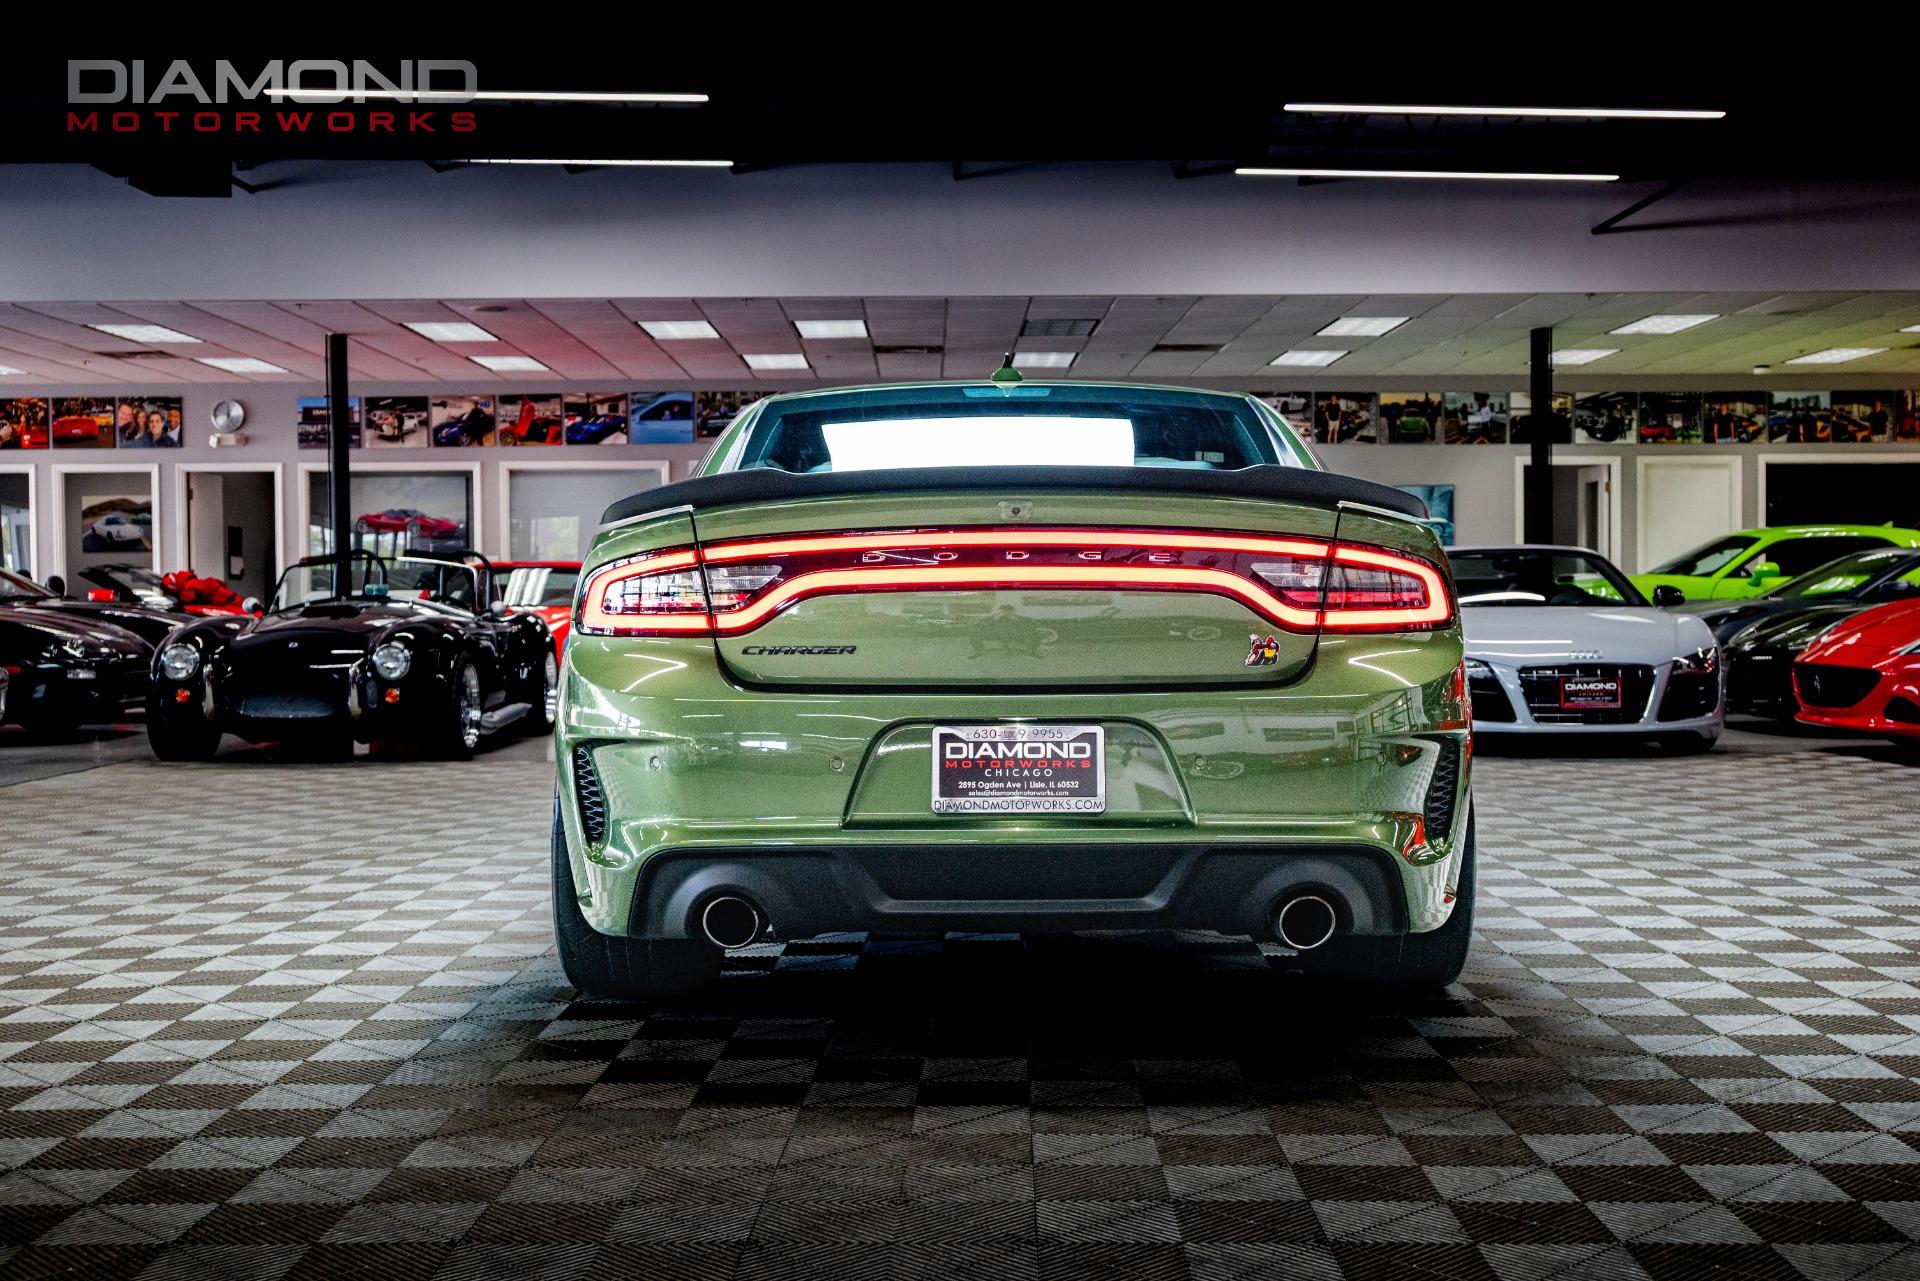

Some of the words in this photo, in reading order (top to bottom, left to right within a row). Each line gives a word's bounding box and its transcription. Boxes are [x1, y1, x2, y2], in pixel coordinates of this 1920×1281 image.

[862, 550, 1171, 563] DODGE
[741, 645, 857, 655] CHARGER
[1565, 682, 1617, 690] DIAMOND
[973, 729, 1063, 739] 630-59-9955
[945, 742, 1091, 759] DIAMOND
[945, 760, 1091, 768] MOTORWORKS
[984, 769, 1053, 777] CHICAGO
[958, 781, 976, 789] 2895
[978, 781, 1004, 790] Ogden
[1006, 781, 1021, 789] Ave
[934, 799, 1104, 811] DIAMONDMOTORWORKS.COM
